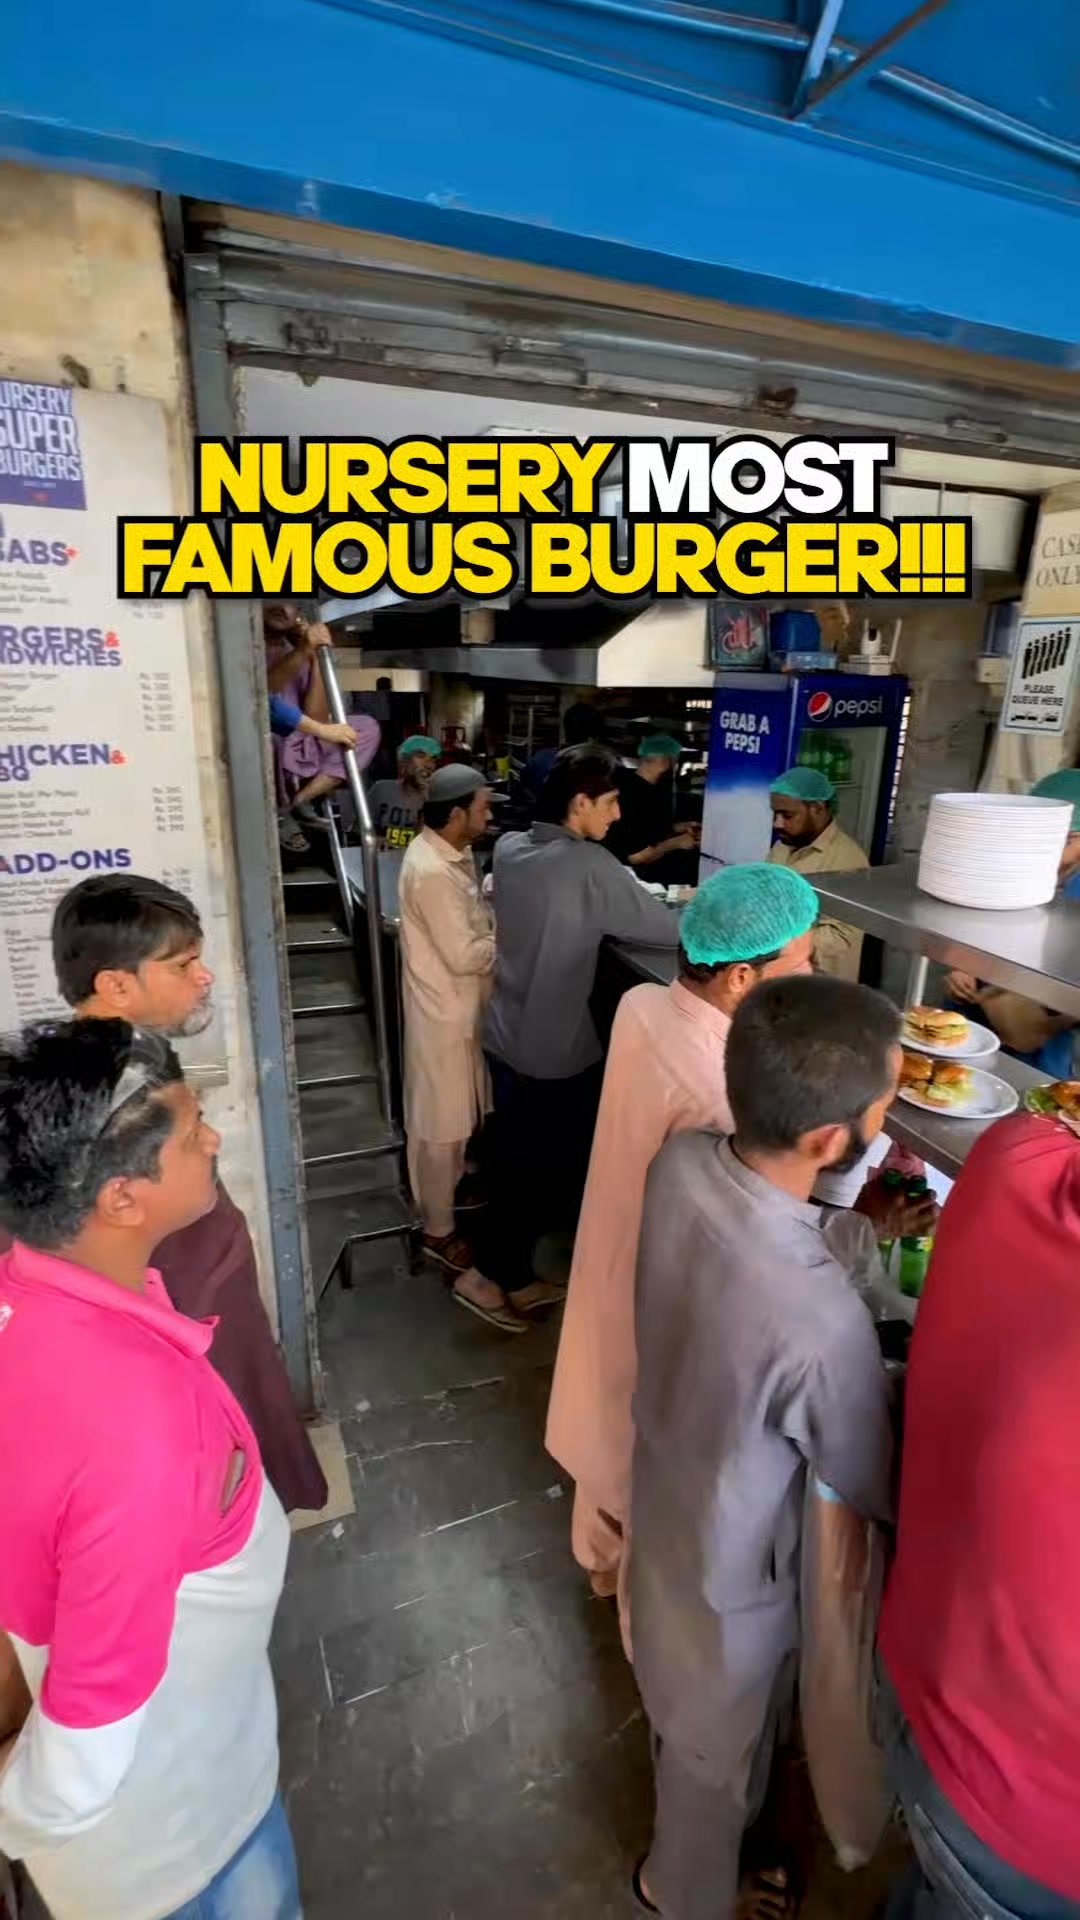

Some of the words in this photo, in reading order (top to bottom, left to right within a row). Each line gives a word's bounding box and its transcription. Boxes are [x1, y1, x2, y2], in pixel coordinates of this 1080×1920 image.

[1024, 684, 1056, 694] PLEASE
[833, 696, 883, 718] pepsi
[1012, 695, 1040, 705] QUEUE
[1041, 696, 1064, 707] HERE
[719, 711, 756, 732] GRAB
[759, 716, 770, 735] A
[725, 732, 760, 754] PEPSI
